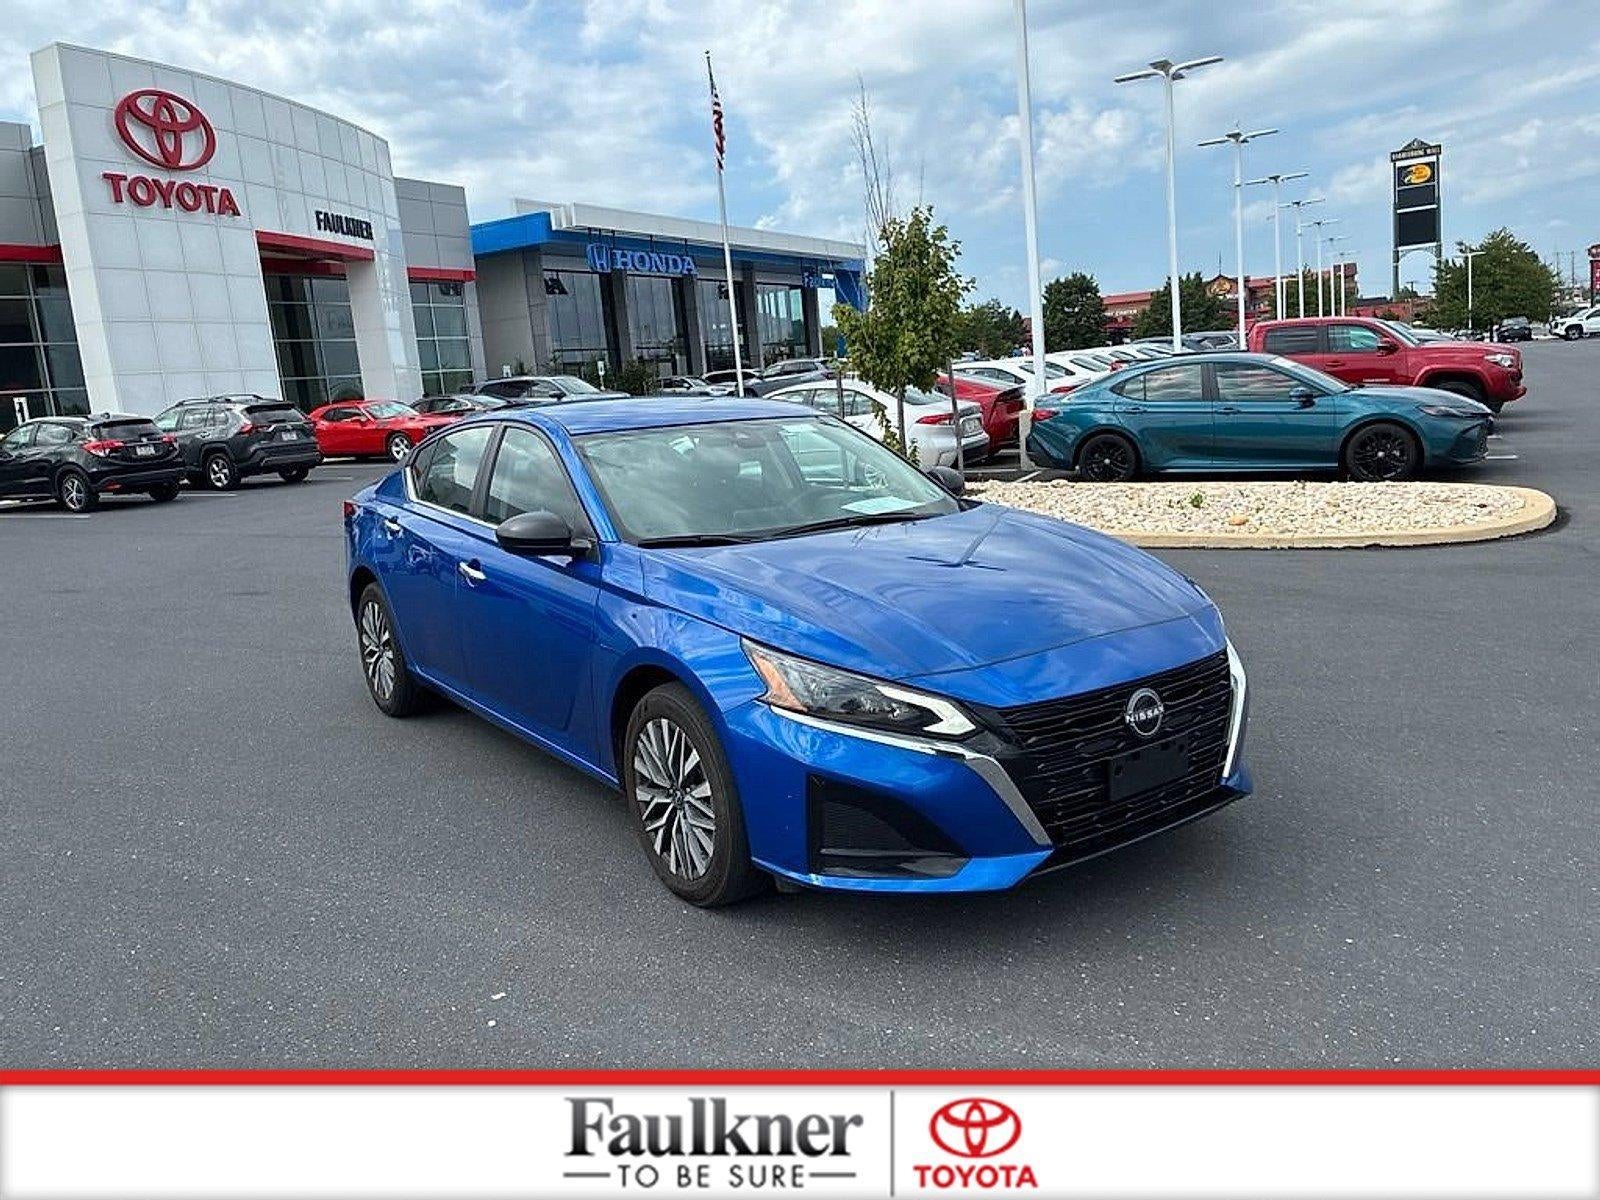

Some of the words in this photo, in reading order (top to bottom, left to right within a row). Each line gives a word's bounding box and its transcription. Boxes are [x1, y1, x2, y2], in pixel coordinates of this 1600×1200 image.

[102, 172, 241, 217] TOYOTA
[315, 210, 374, 241] FAULKNER
[612, 249, 699, 278] HONDA
